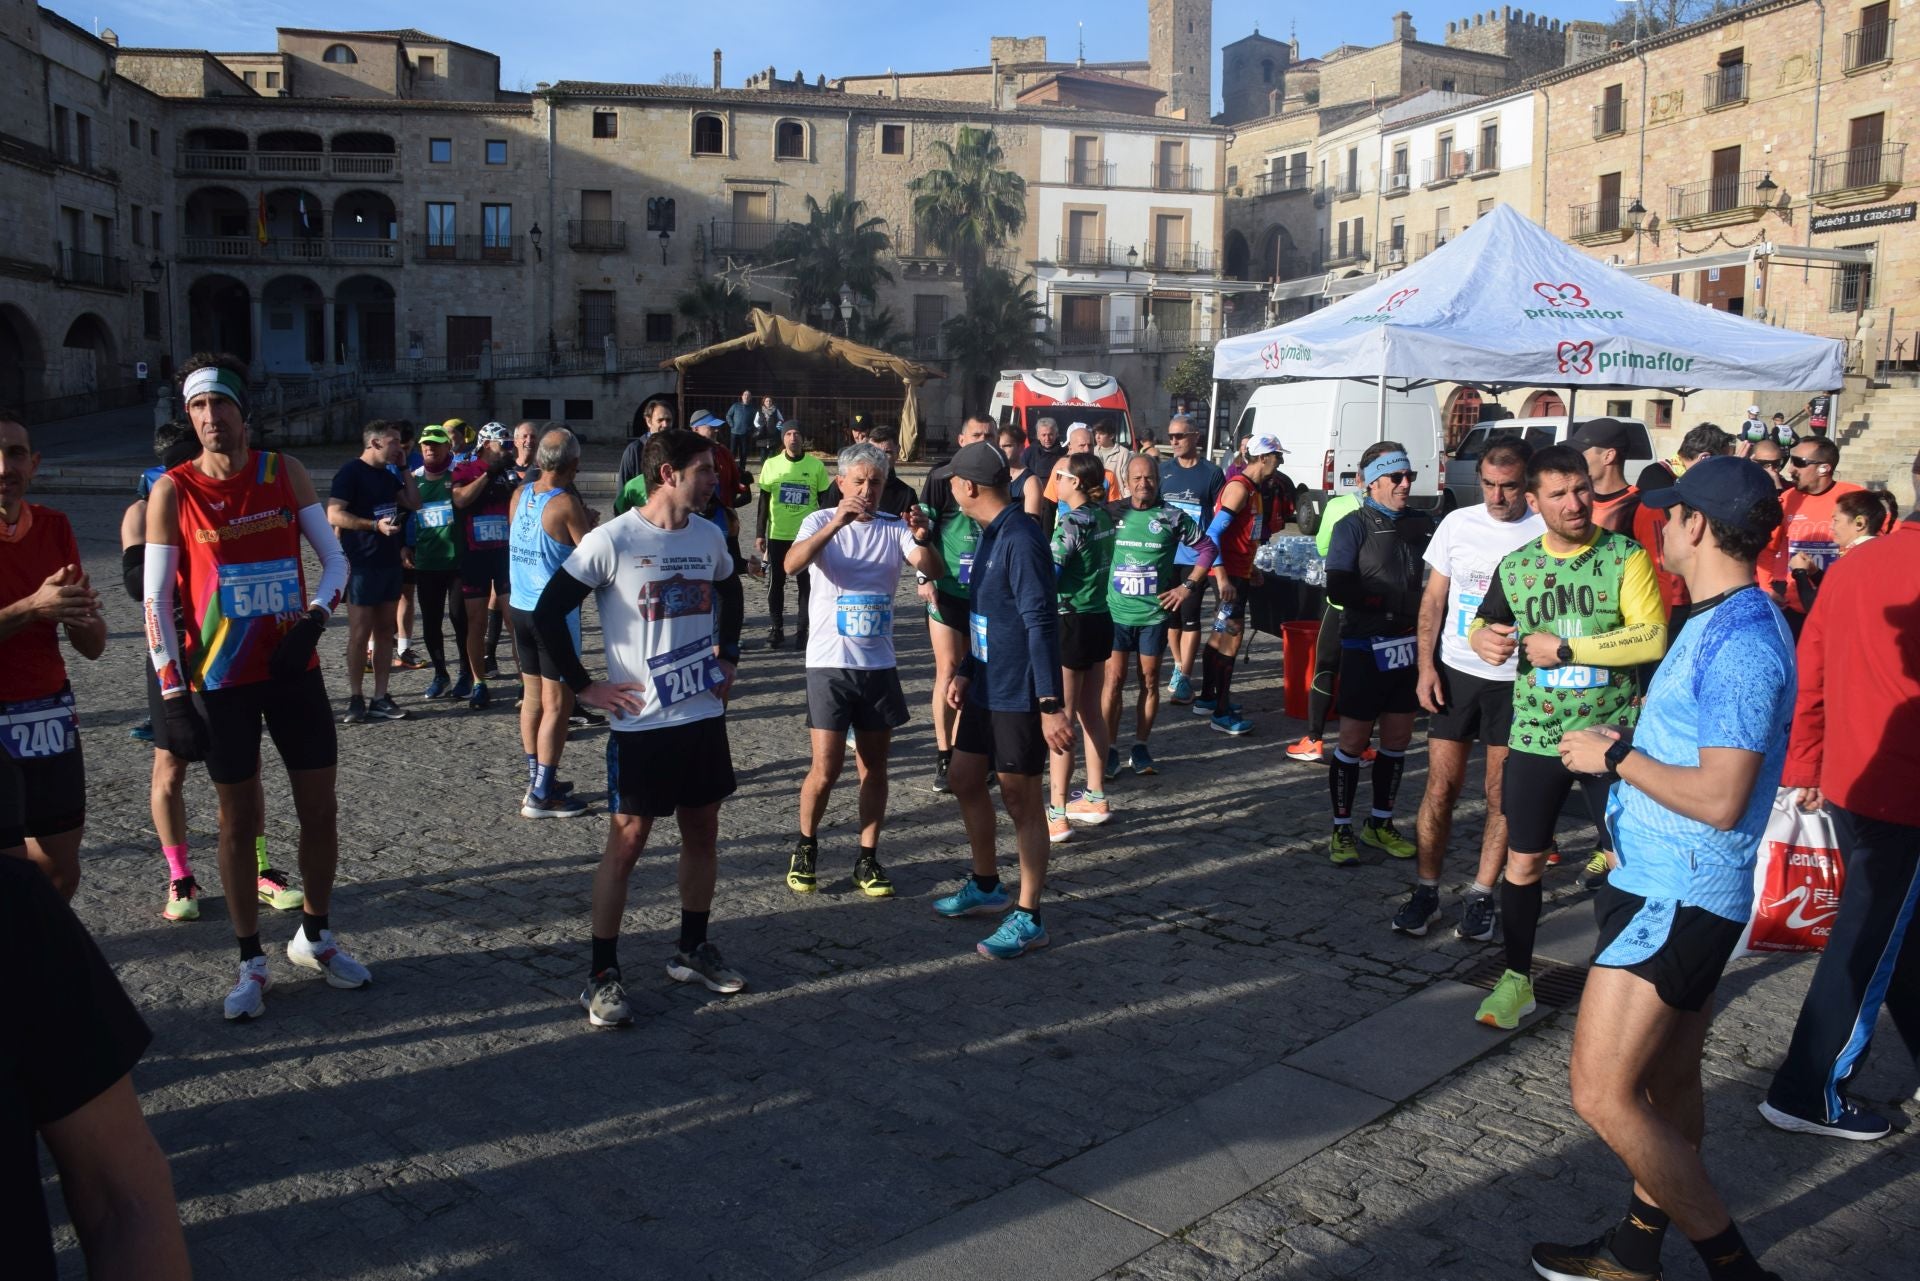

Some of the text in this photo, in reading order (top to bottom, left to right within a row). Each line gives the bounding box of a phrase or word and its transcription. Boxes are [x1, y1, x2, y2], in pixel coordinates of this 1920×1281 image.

[1850, 214, 1861, 223] LA
[1863, 208, 1901, 221] CADENA
[1524, 308, 1624, 320] primaflor
[1599, 350, 1694, 373] primaflor
[423, 511, 444, 526] 531
[480, 525, 503, 541] 545
[1120, 578, 1146, 595] 201
[234, 581, 285, 617] 546
[1525, 583, 1595, 628] COMO
[846, 612, 881, 636] 562
[1556, 619, 1584, 638] UNA
[1385, 643, 1414, 669] 241
[665, 661, 706, 703] 247
[11, 719, 65, 757] 240
